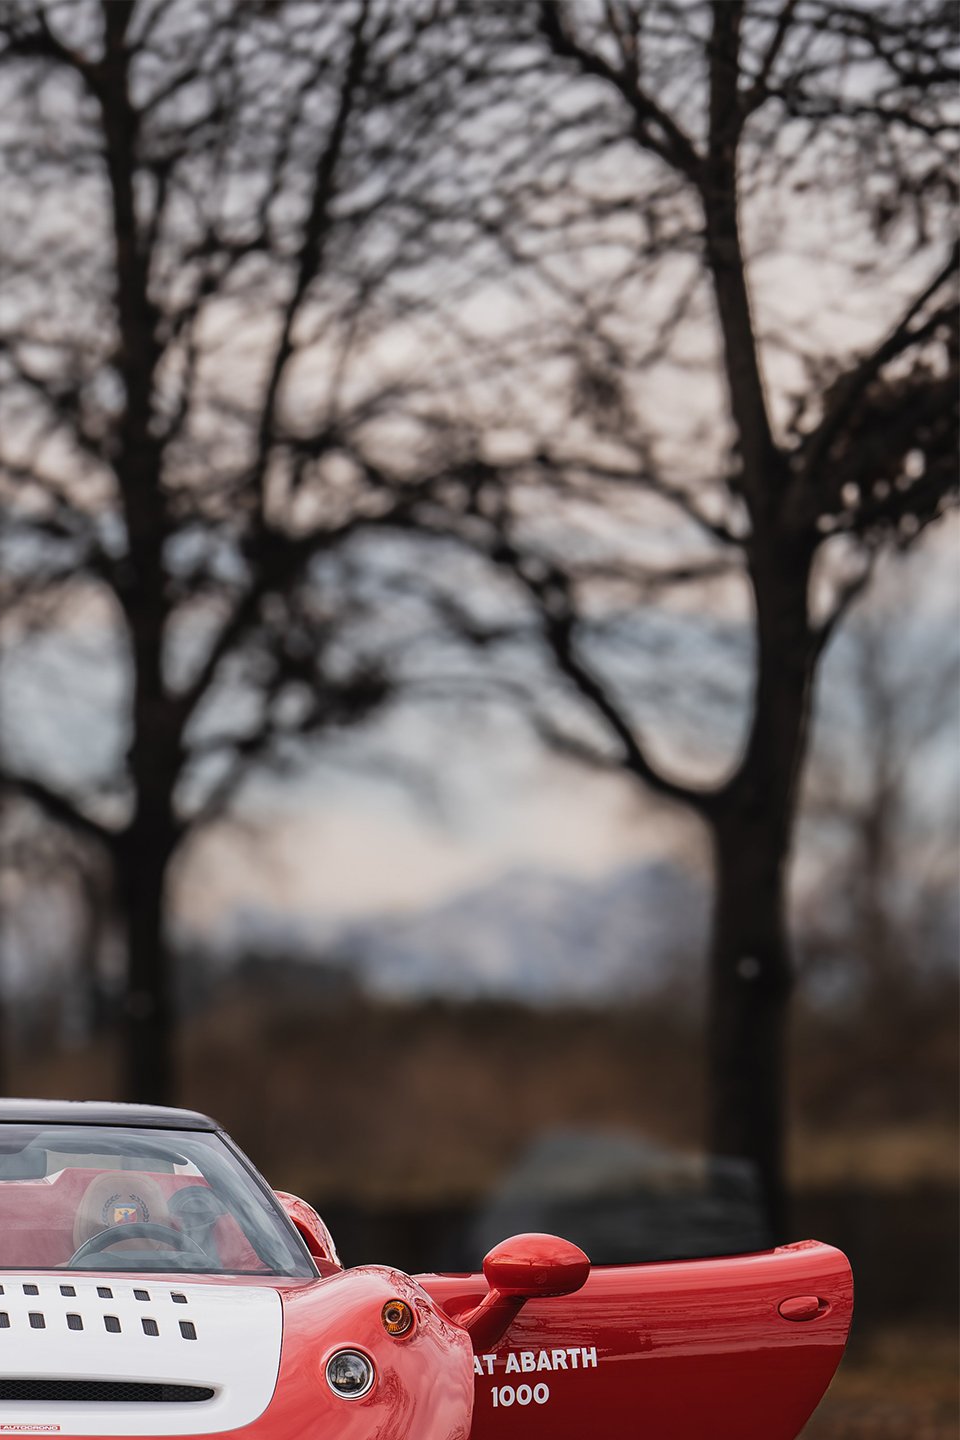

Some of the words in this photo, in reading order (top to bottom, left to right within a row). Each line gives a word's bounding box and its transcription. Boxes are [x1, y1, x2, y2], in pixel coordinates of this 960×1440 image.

[473, 1354, 497, 1375] AT
[505, 1347, 597, 1374] ABARTH
[491, 1383, 549, 1407] 1000
